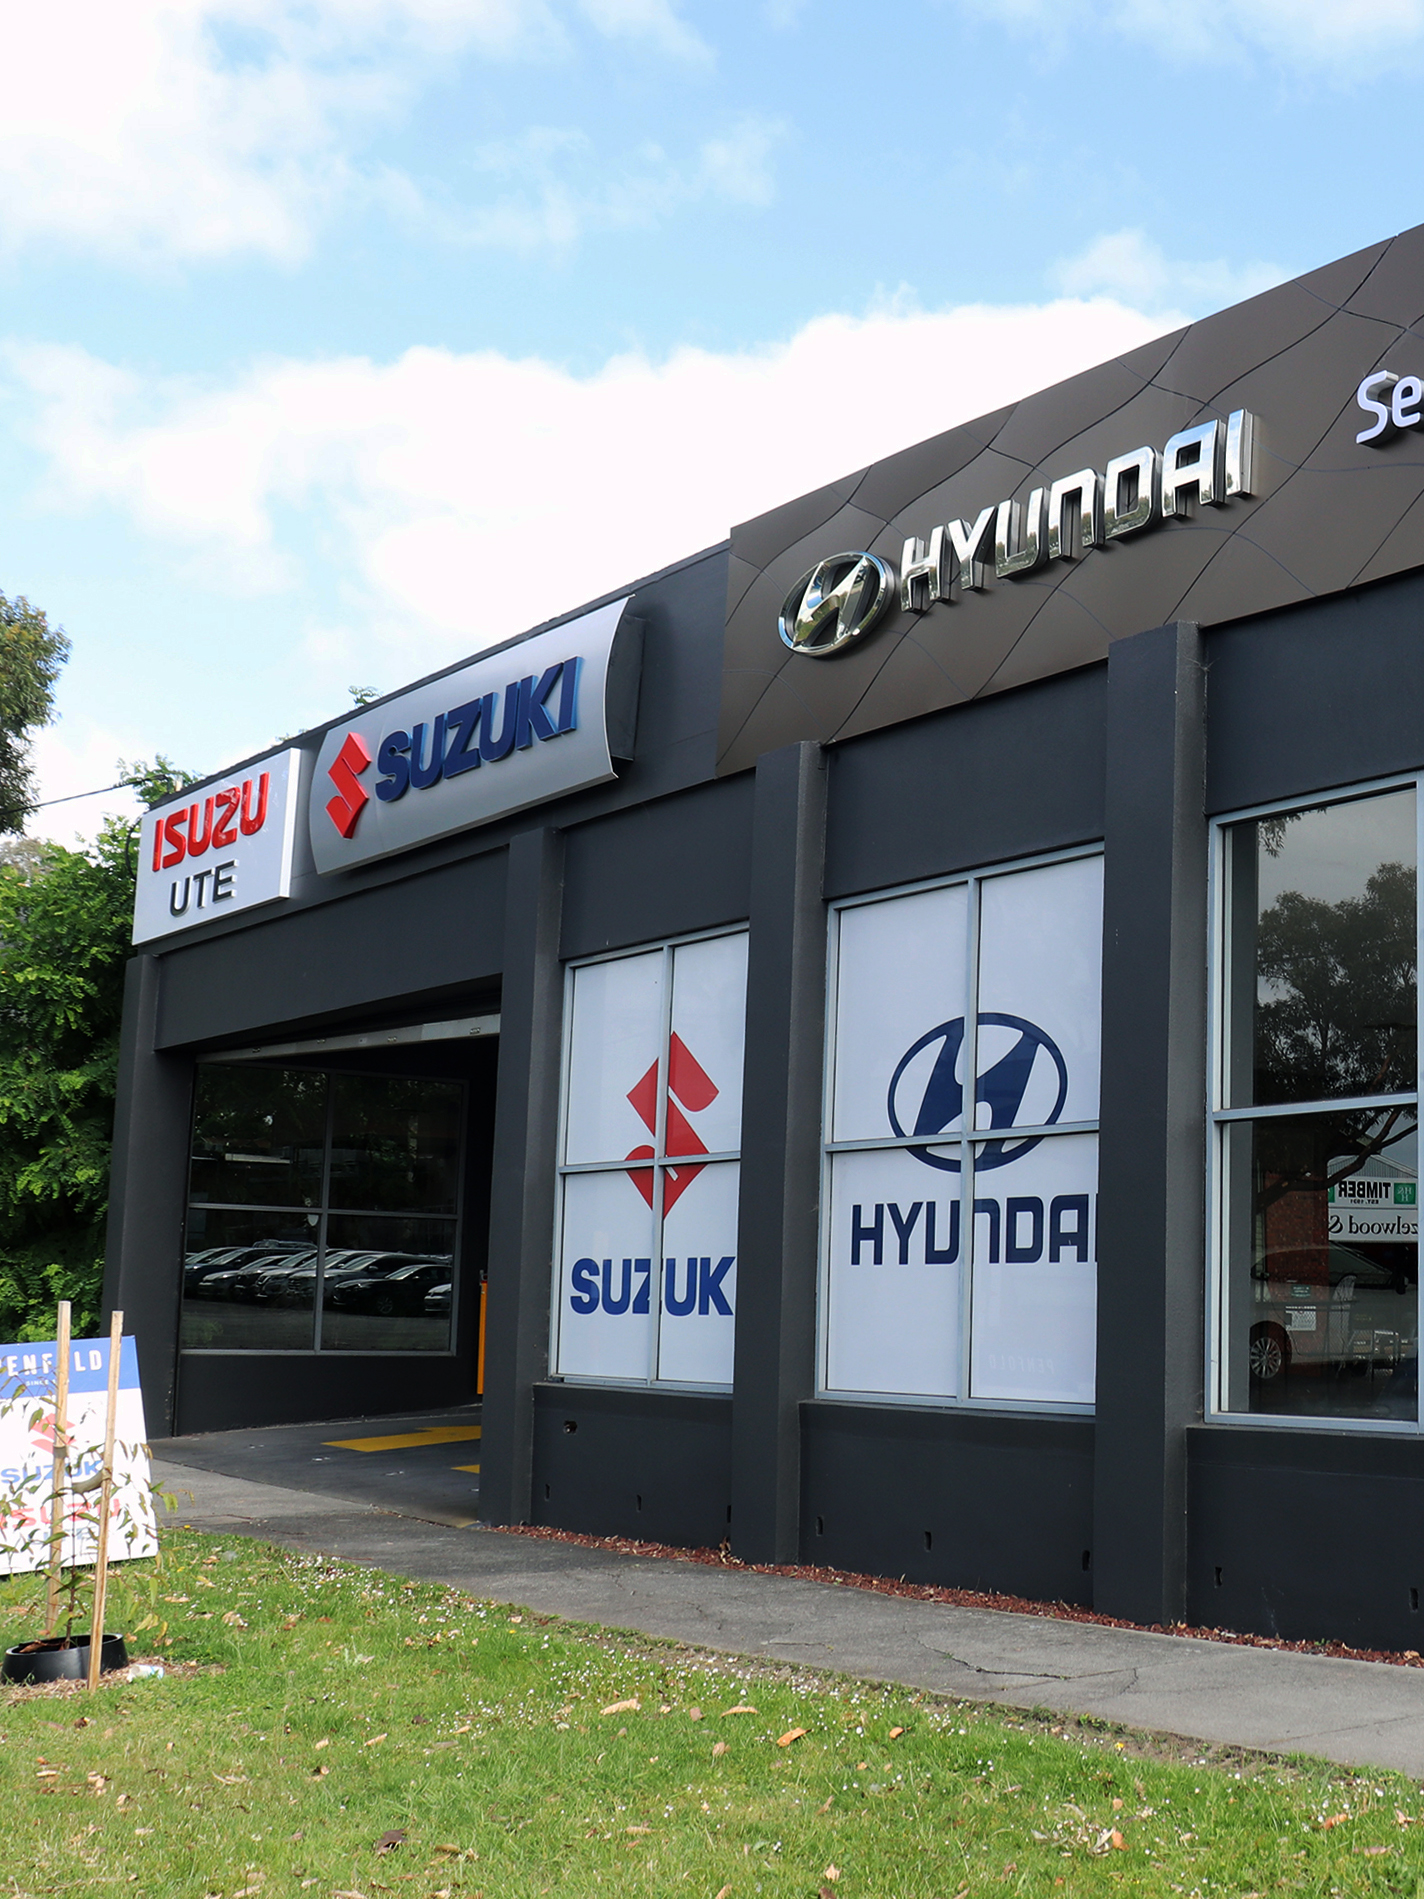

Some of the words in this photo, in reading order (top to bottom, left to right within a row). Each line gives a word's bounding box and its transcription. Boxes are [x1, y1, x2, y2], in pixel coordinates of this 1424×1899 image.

[900, 408, 1253, 612] HYUNDAI
[375, 656, 583, 802] SUZUKI
[152, 772, 270, 872] ISUZU
[170, 859, 239, 917] UTE
[851, 1193, 1098, 1266] HYUNDA
[570, 1256, 736, 1317] SUZUK
[0, 1349, 103, 1377] ENFLD
